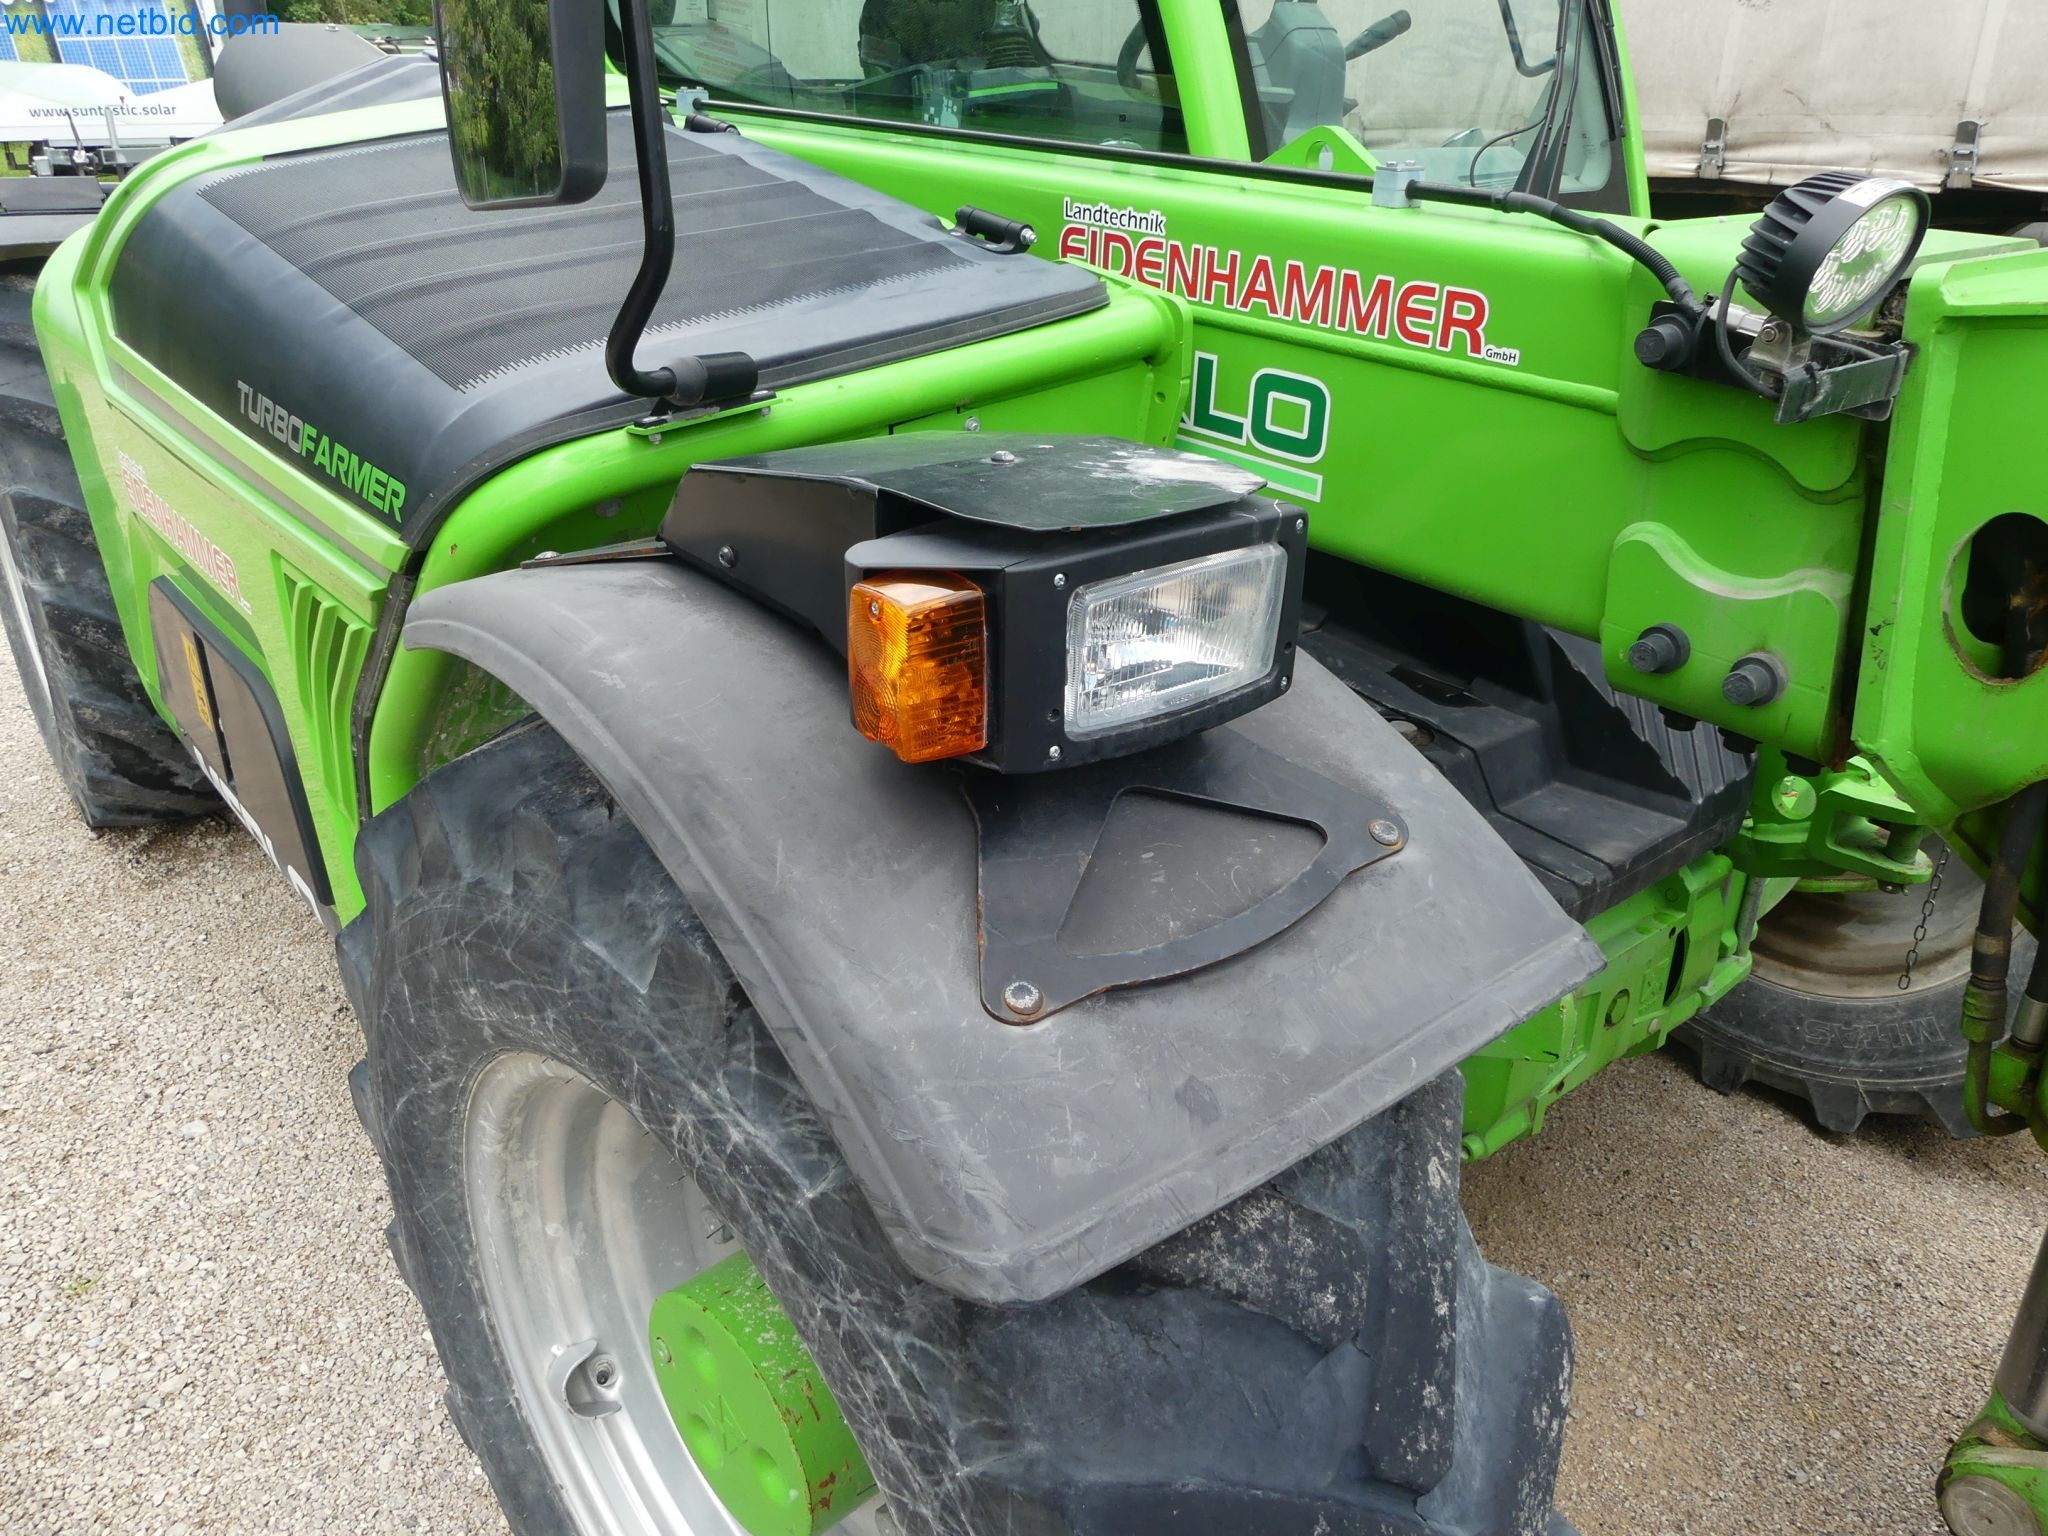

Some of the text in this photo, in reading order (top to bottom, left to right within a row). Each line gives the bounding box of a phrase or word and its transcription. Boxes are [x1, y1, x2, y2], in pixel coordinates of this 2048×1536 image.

[1065, 200, 1164, 233] Landtechnik
[1485, 348, 1517, 363] GmbH
[237, 380, 406, 524] TURBOFARMER
[1804, 1016, 1945, 1049] MITAS
